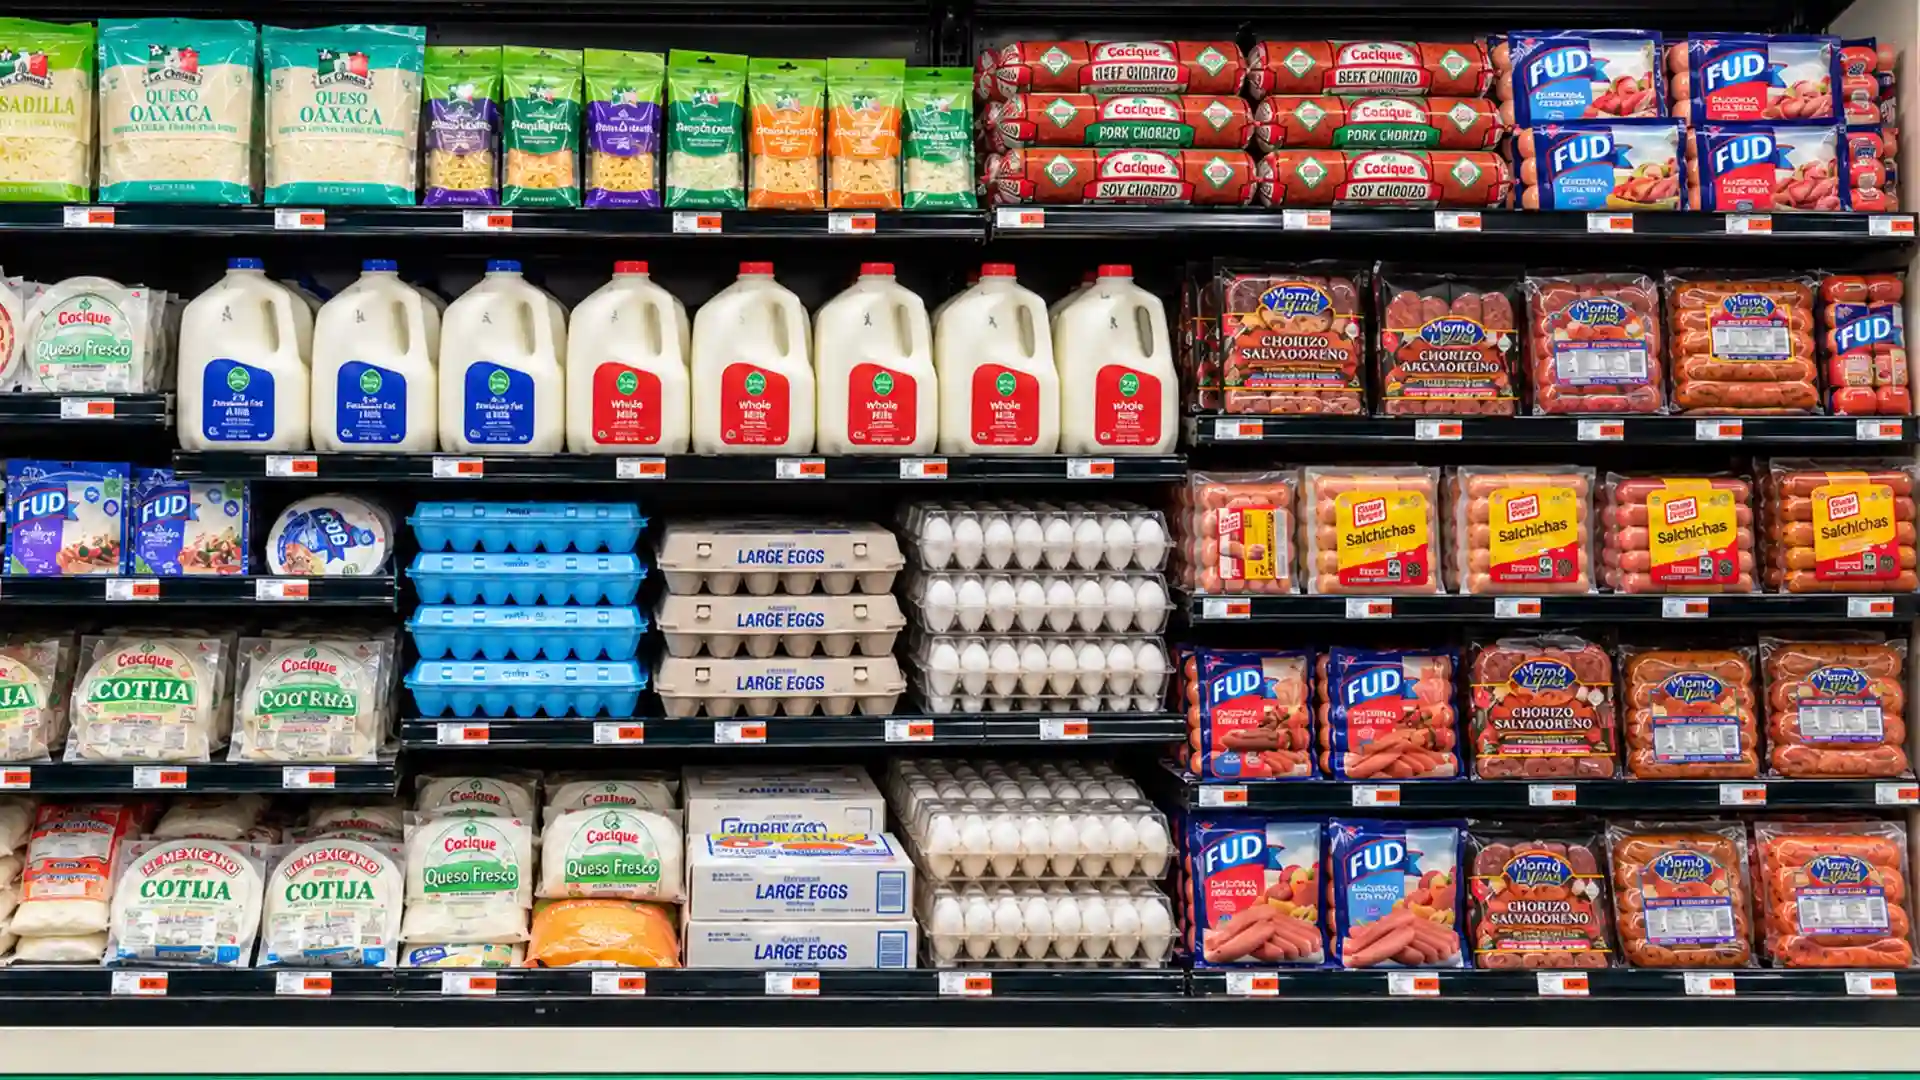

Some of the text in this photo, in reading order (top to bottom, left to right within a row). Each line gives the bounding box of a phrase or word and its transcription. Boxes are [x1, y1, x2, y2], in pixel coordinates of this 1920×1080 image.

[1530, 50, 1588, 87] FUD
[1707, 54, 1764, 89] FUD
[146, 89, 198, 103] QUESO
[315, 90, 368, 105] QUESO
[130, 105, 212, 122] OAXACA
[300, 107, 382, 124] OAXACA
[1099, 126, 1129, 139] PORK
[1347, 129, 1376, 140] PORK
[1554, 136, 1610, 172] FUD
[1716, 136, 1772, 173] FUD
[1101, 184, 1125, 196] SOY
[1351, 184, 1375, 197] SOY
[1841, 317, 1890, 349] FUD
[37, 340, 130, 360] Queso Fresco
[739, 400, 771, 410] Whole
[866, 401, 898, 410] Whole
[990, 401, 1021, 411] Whole
[18, 493, 66, 520] FUD
[143, 496, 187, 523] FUD
[1346, 524, 1416, 546] Salchichas
[1499, 520, 1568, 542] Salchichas
[1658, 522, 1728, 544] Salchichas
[737, 549, 825, 564] LARGE EGGS
[737, 612, 825, 628] LARGE EGGS
[95, 681, 190, 701] COTIJA
[736, 675, 825, 691] LARGE EGGS
[1213, 670, 1261, 702] FUD
[1347, 669, 1401, 704] FUD
[162, 848, 238, 874] MEXICANO
[304, 849, 379, 874] MEXICANO
[1205, 836, 1263, 873] FUD
[1351, 842, 1404, 878] FUD
[425, 866, 517, 886] Queso Fresco
[567, 860, 658, 879] Queso Fresco
[140, 879, 232, 900] COTIJA
[285, 881, 375, 902] COTIJA
[755, 884, 849, 900] LARGE EGGS
[1507, 902, 1570, 912] CHORIZO
[754, 944, 848, 960] LARGE EGGS
